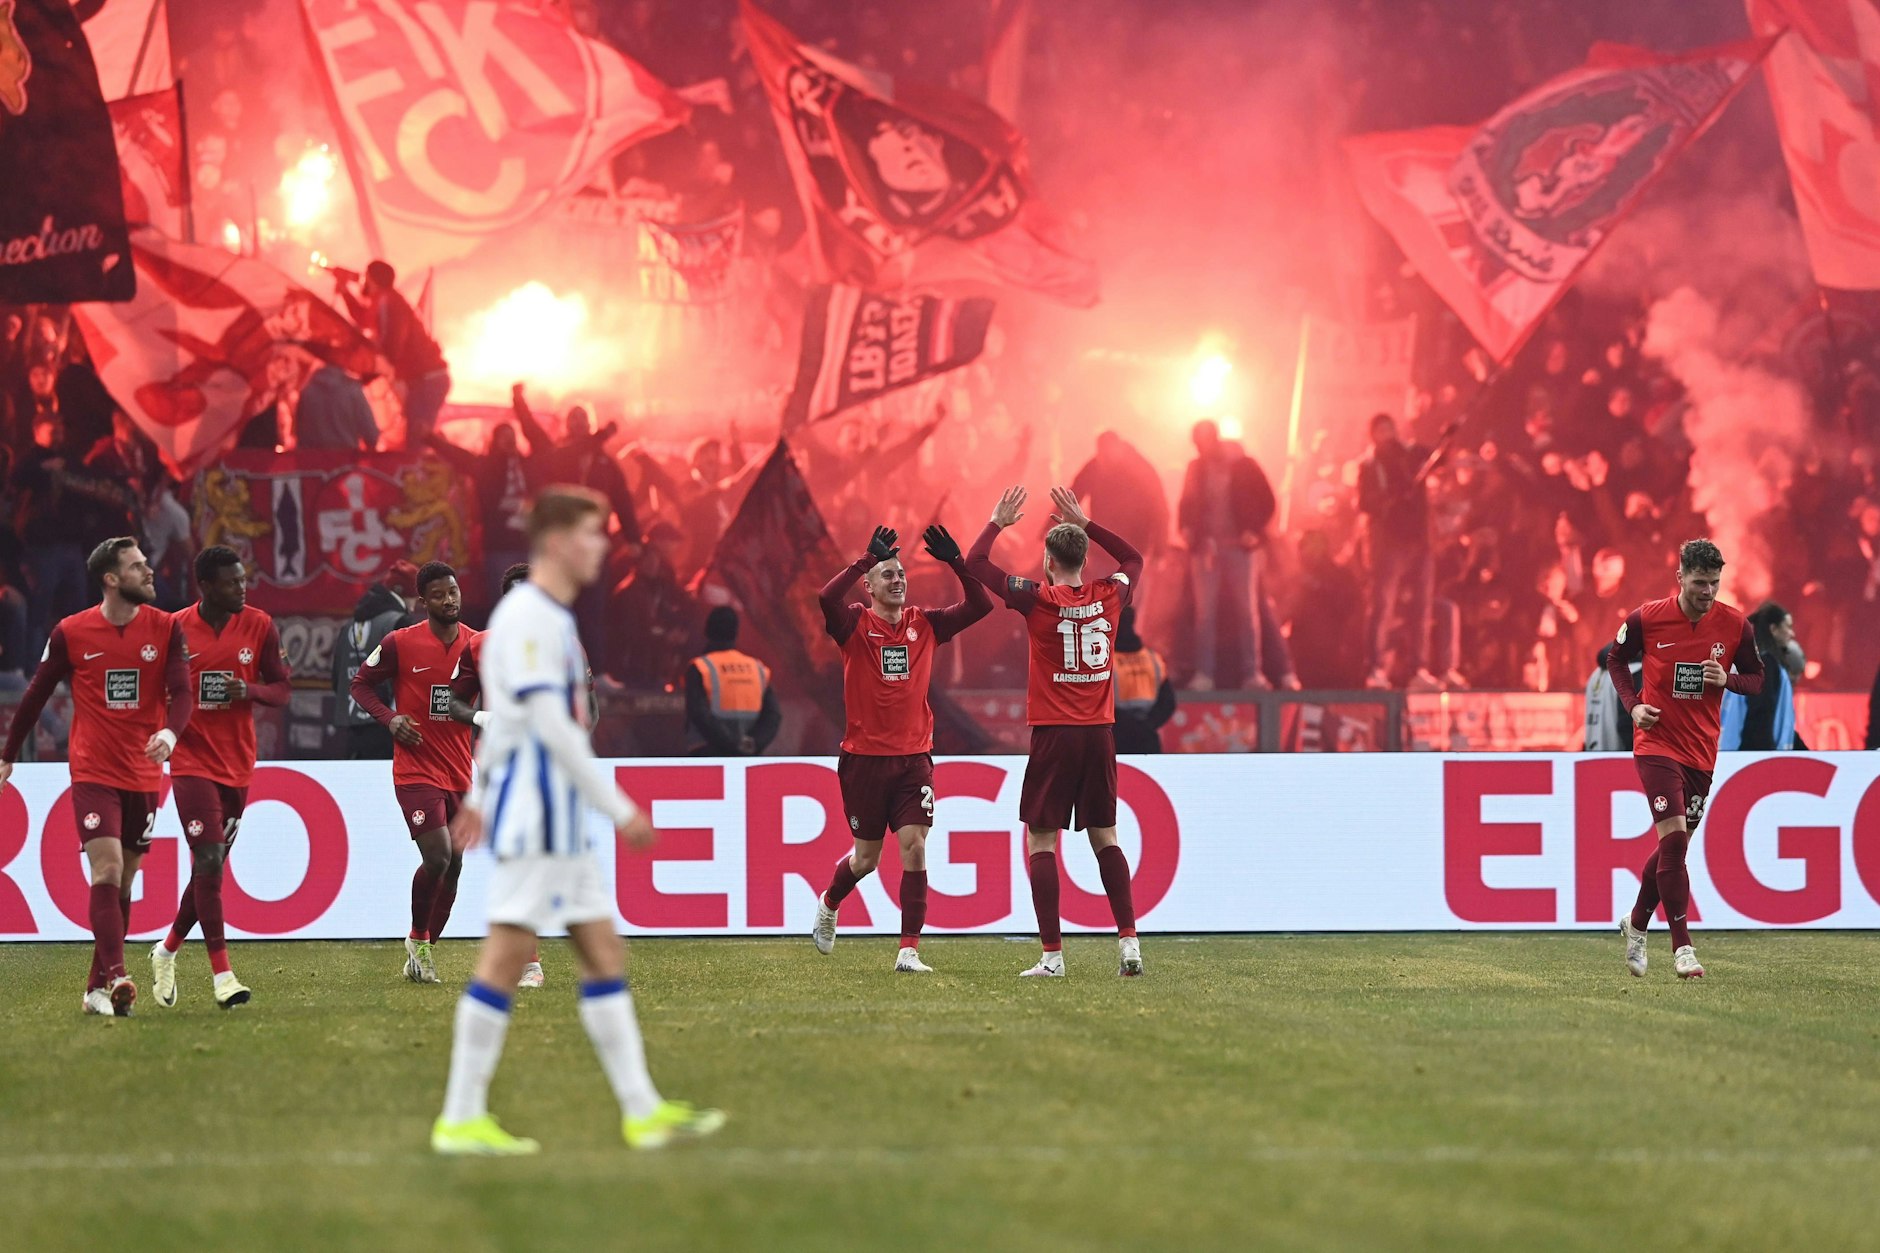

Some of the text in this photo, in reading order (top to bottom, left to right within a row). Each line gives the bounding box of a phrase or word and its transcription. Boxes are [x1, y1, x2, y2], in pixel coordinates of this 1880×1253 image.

[1059, 601, 1104, 619] NIEHUES
[1056, 617, 1112, 672] 16
[884, 650, 905, 658] Allgäuer
[1677, 674, 1701, 682] Latschen
[1678, 667, 1702, 675] Allgäuer
[615, 760, 1180, 928] ERGO
[1443, 756, 1880, 925] ERG
